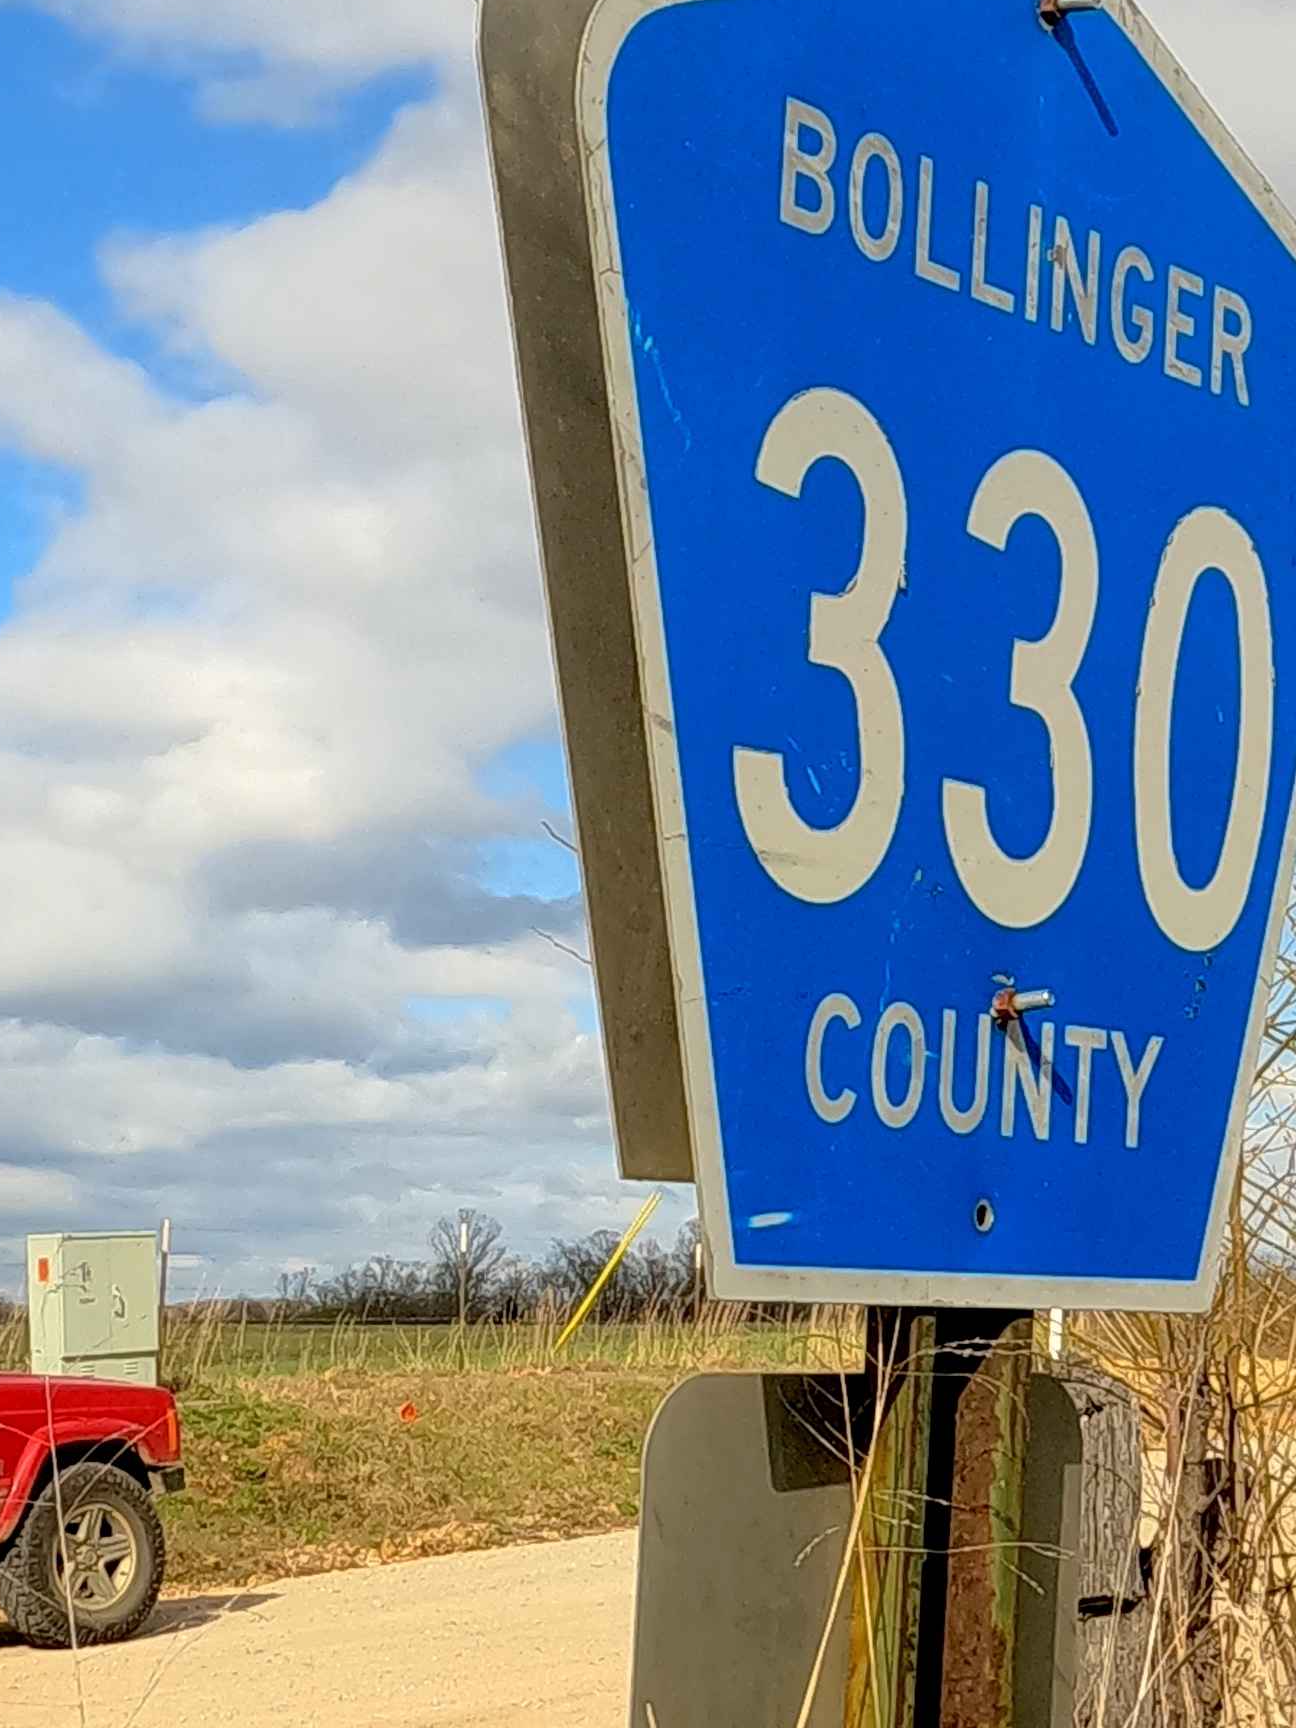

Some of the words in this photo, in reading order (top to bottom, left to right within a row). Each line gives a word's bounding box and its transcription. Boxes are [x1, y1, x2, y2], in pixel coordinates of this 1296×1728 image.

[780, 95, 1252, 407] BOLLINGER
[733, 386, 1274, 951] 330
[806, 992, 1164, 1148] COUNTY
